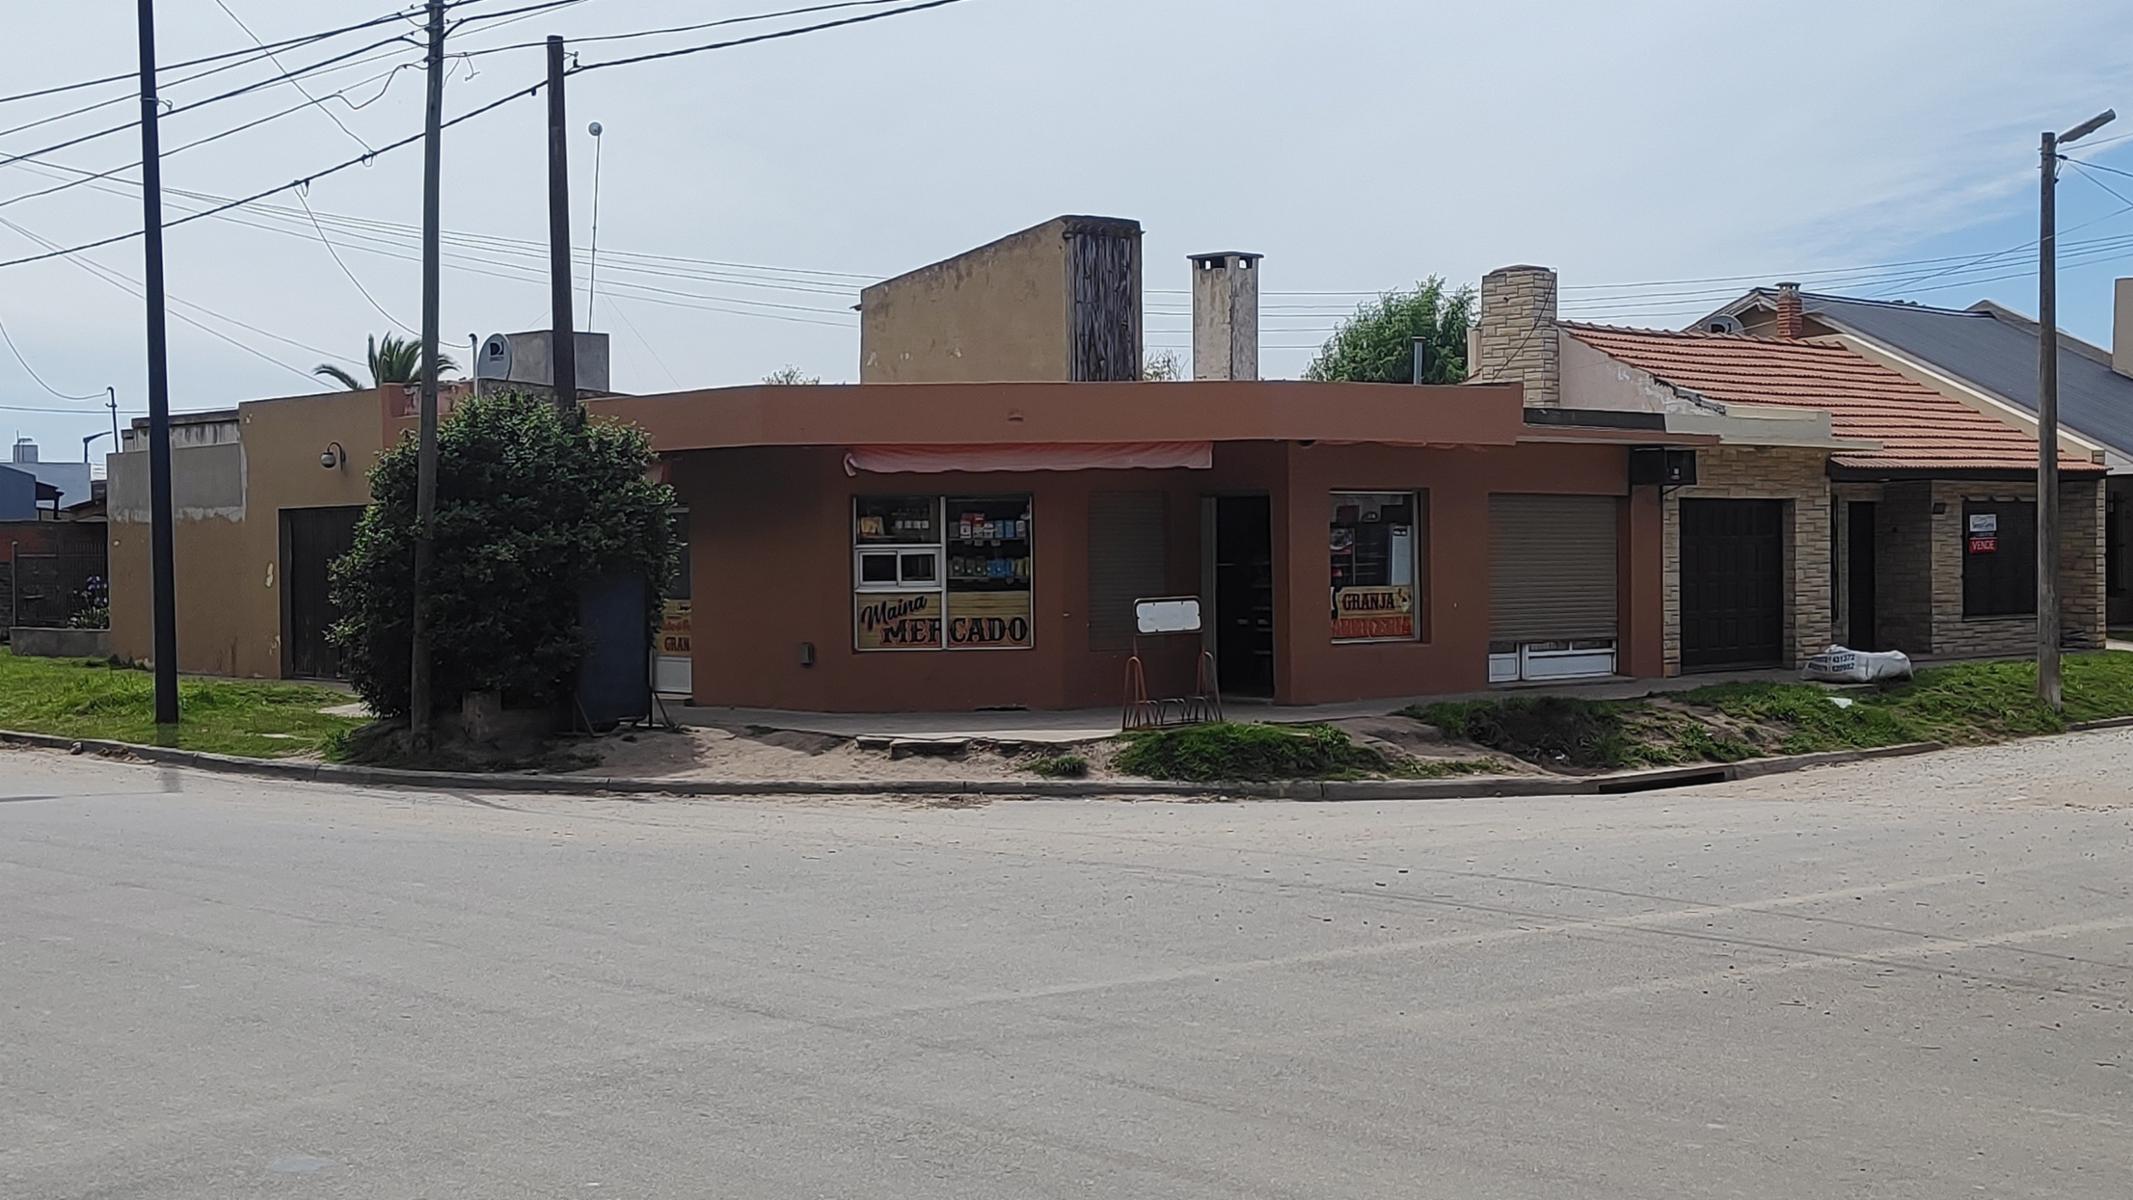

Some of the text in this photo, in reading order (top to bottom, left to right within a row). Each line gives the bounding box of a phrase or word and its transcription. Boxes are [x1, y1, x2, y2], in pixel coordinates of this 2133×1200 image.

[1971, 540, 1995, 551] VENDE
[1342, 592, 1395, 611] GRANJA
[861, 595, 927, 632] Maina
[881, 616, 1028, 644] MERCADO
